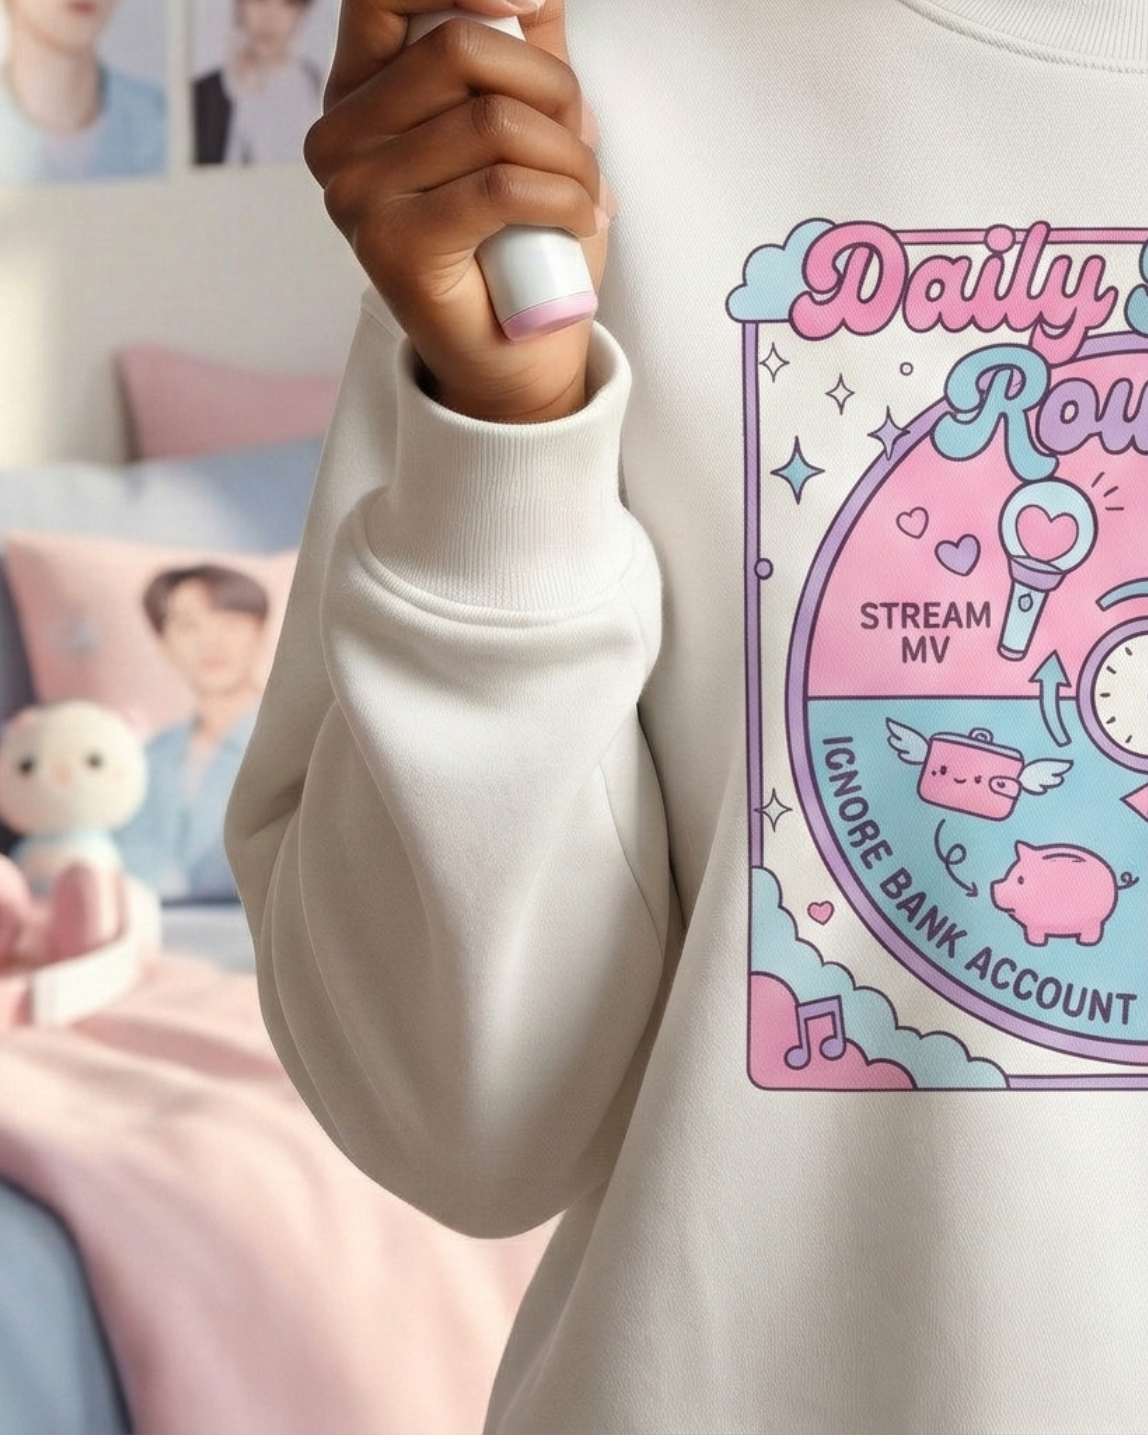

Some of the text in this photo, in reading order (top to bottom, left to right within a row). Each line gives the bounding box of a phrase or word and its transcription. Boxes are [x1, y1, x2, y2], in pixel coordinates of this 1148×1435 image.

[789, 220, 1118, 364] Daily
[859, 601, 992, 631] STREAM
[901, 636, 950, 665] MV
[822, 734, 1138, 1025] IGNORE BANK ACCOUNT
